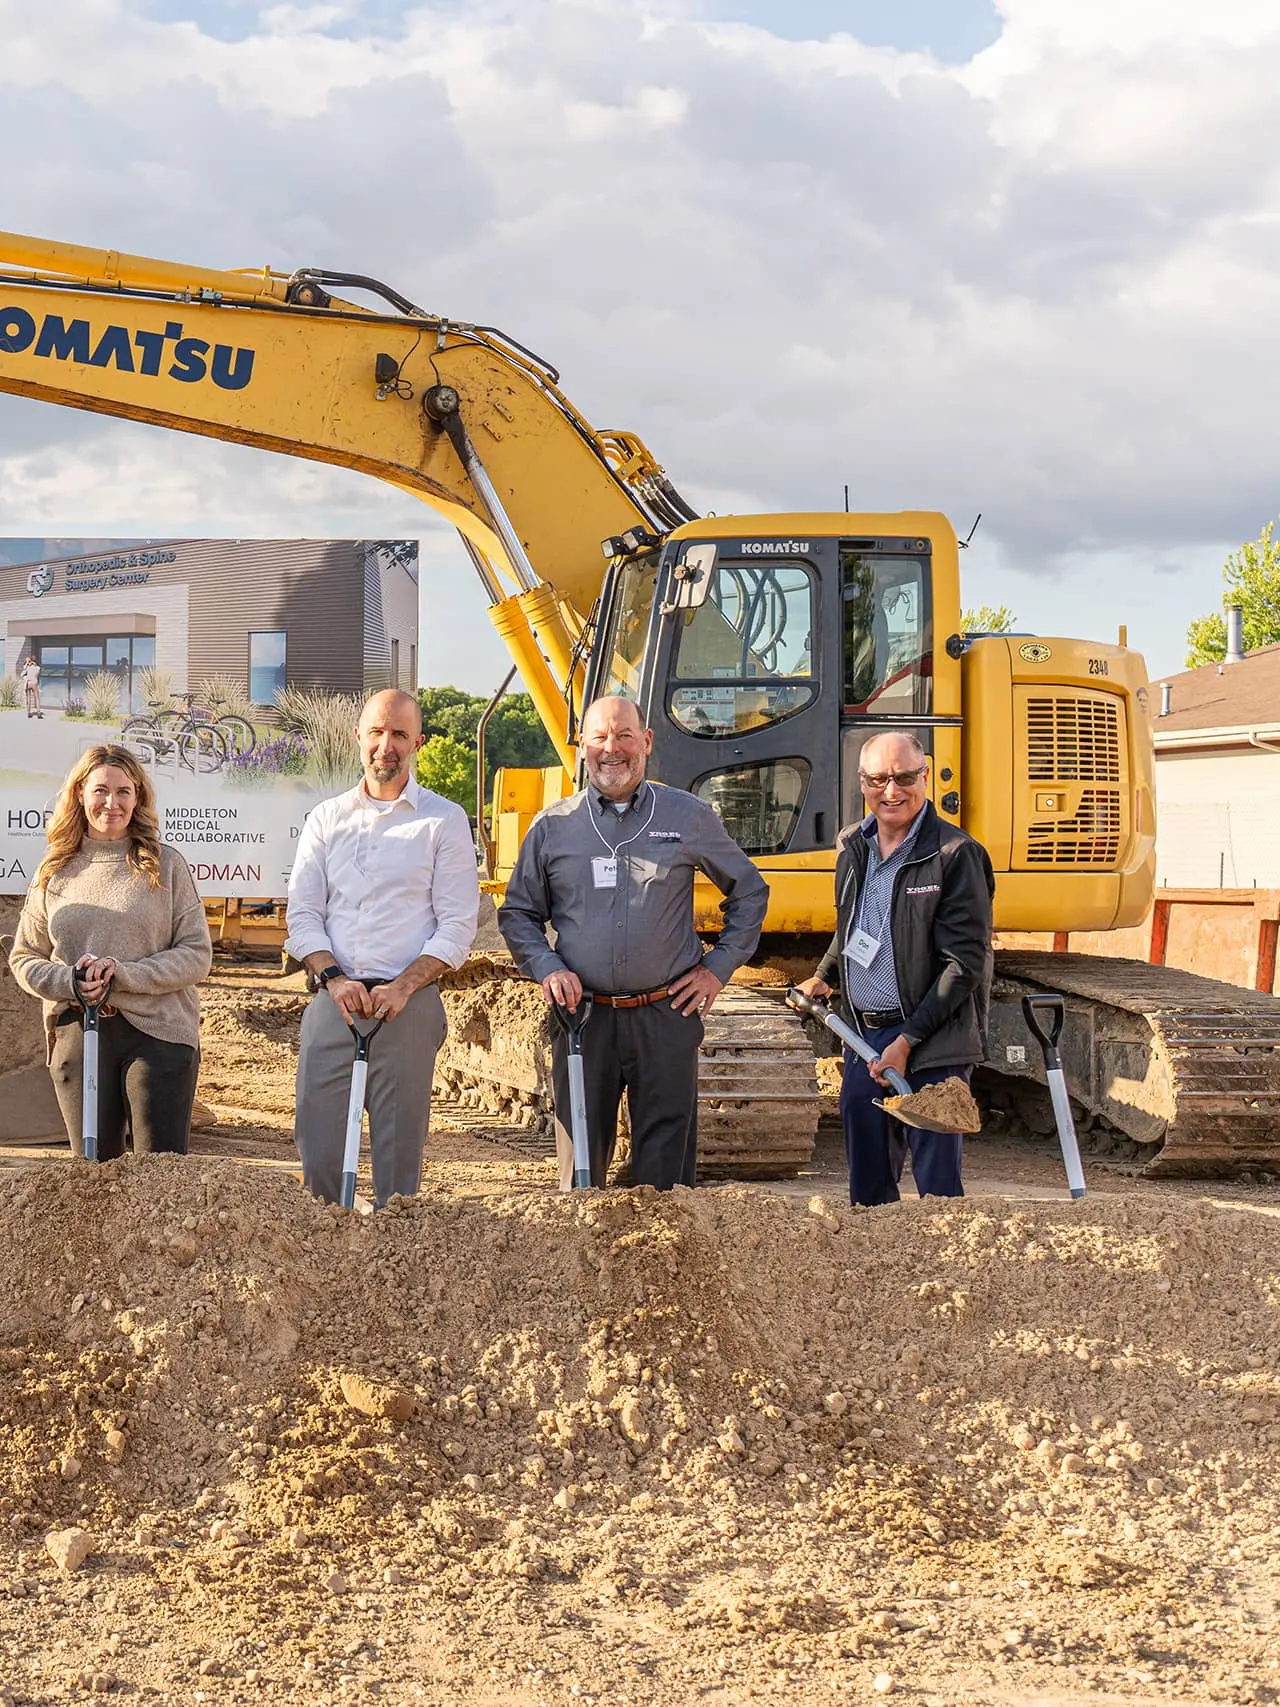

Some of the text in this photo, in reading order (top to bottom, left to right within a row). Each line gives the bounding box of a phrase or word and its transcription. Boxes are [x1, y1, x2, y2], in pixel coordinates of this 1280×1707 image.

[741, 540, 810, 554] KOMATSU
[65, 550, 176, 575] Orthopedic & Spine
[64, 571, 150, 592] Surgery Center
[165, 808, 238, 819] MIDDLETON
[165, 820, 221, 831] MEDICAL
[164, 832, 265, 844] COLLABORATIVE
